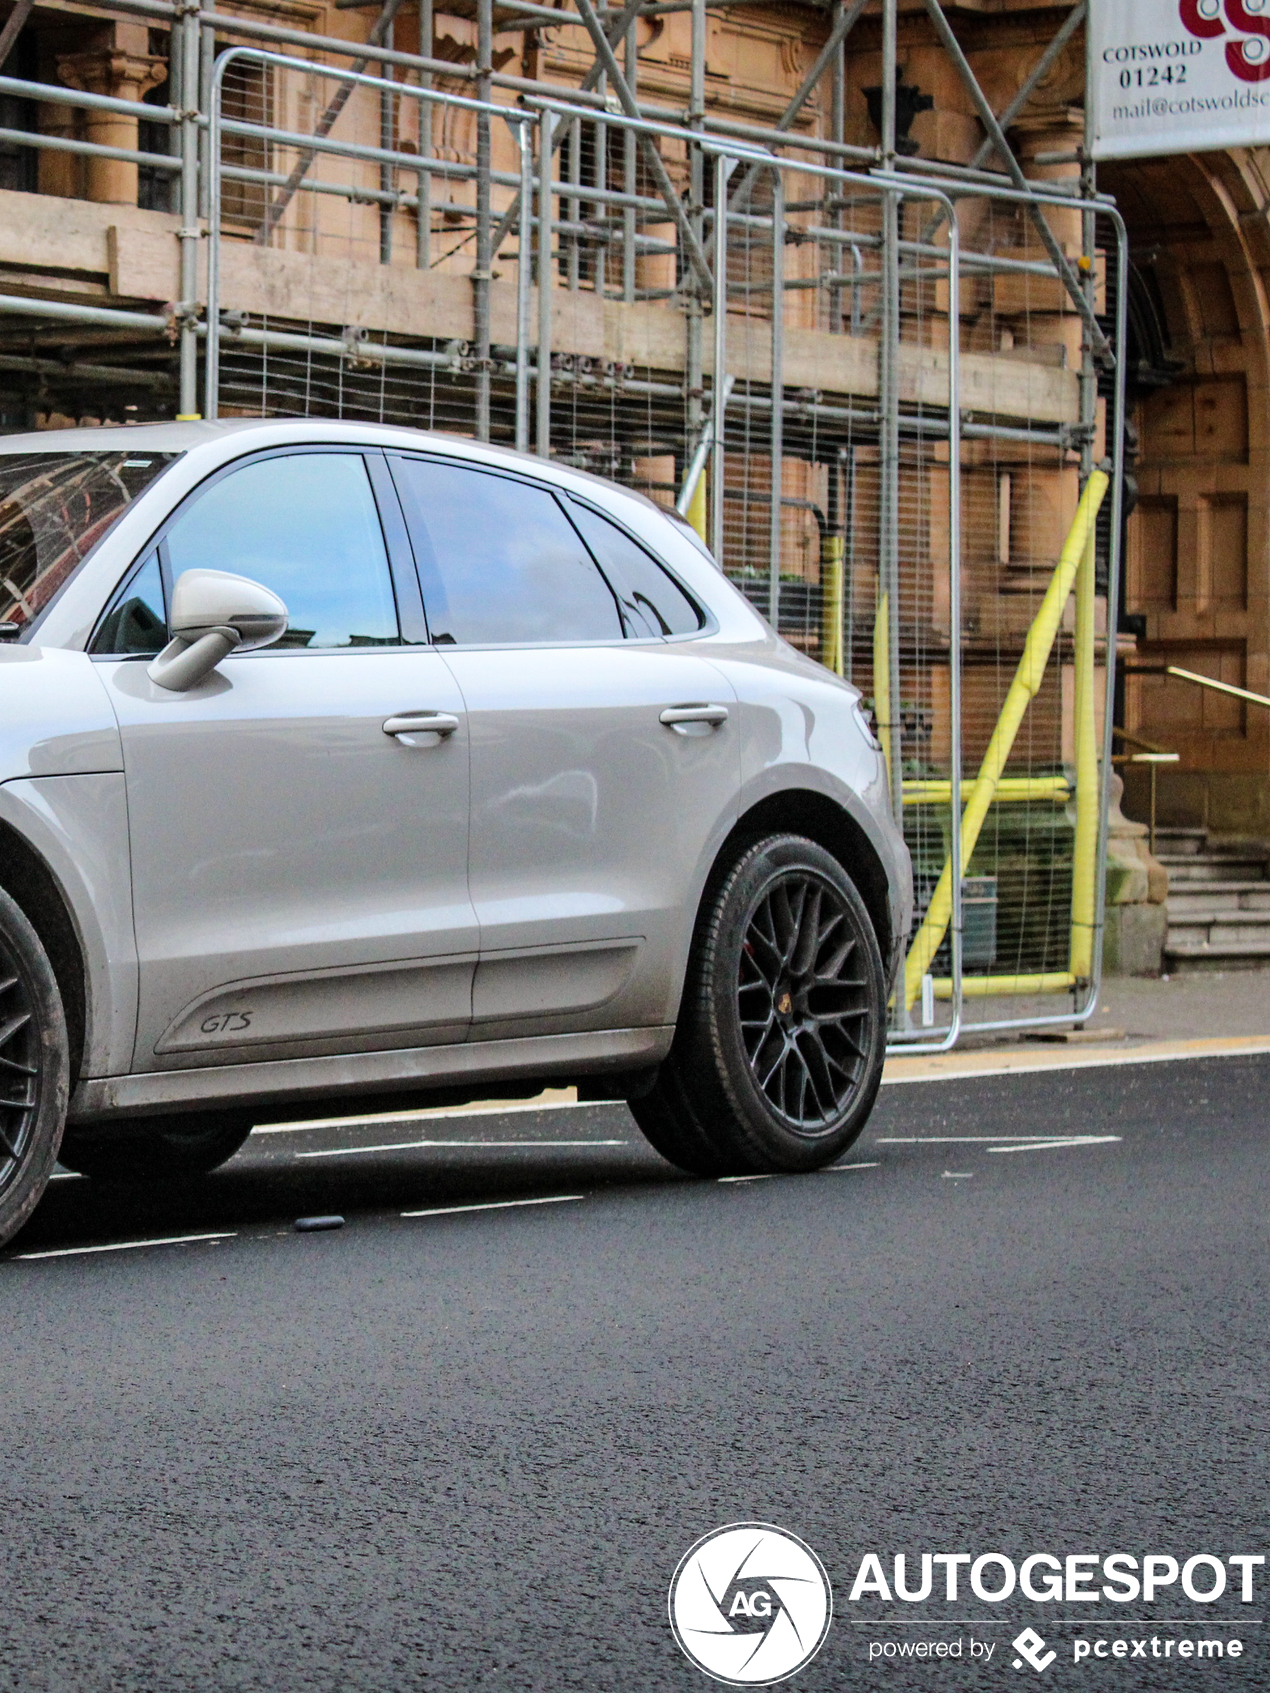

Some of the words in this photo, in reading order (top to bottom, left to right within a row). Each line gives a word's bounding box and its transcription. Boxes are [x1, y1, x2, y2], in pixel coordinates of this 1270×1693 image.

[1103, 40, 1203, 64] COTSWOLD
[1119, 64, 1188, 90] 01242
[200, 1011, 254, 1033] GTS
